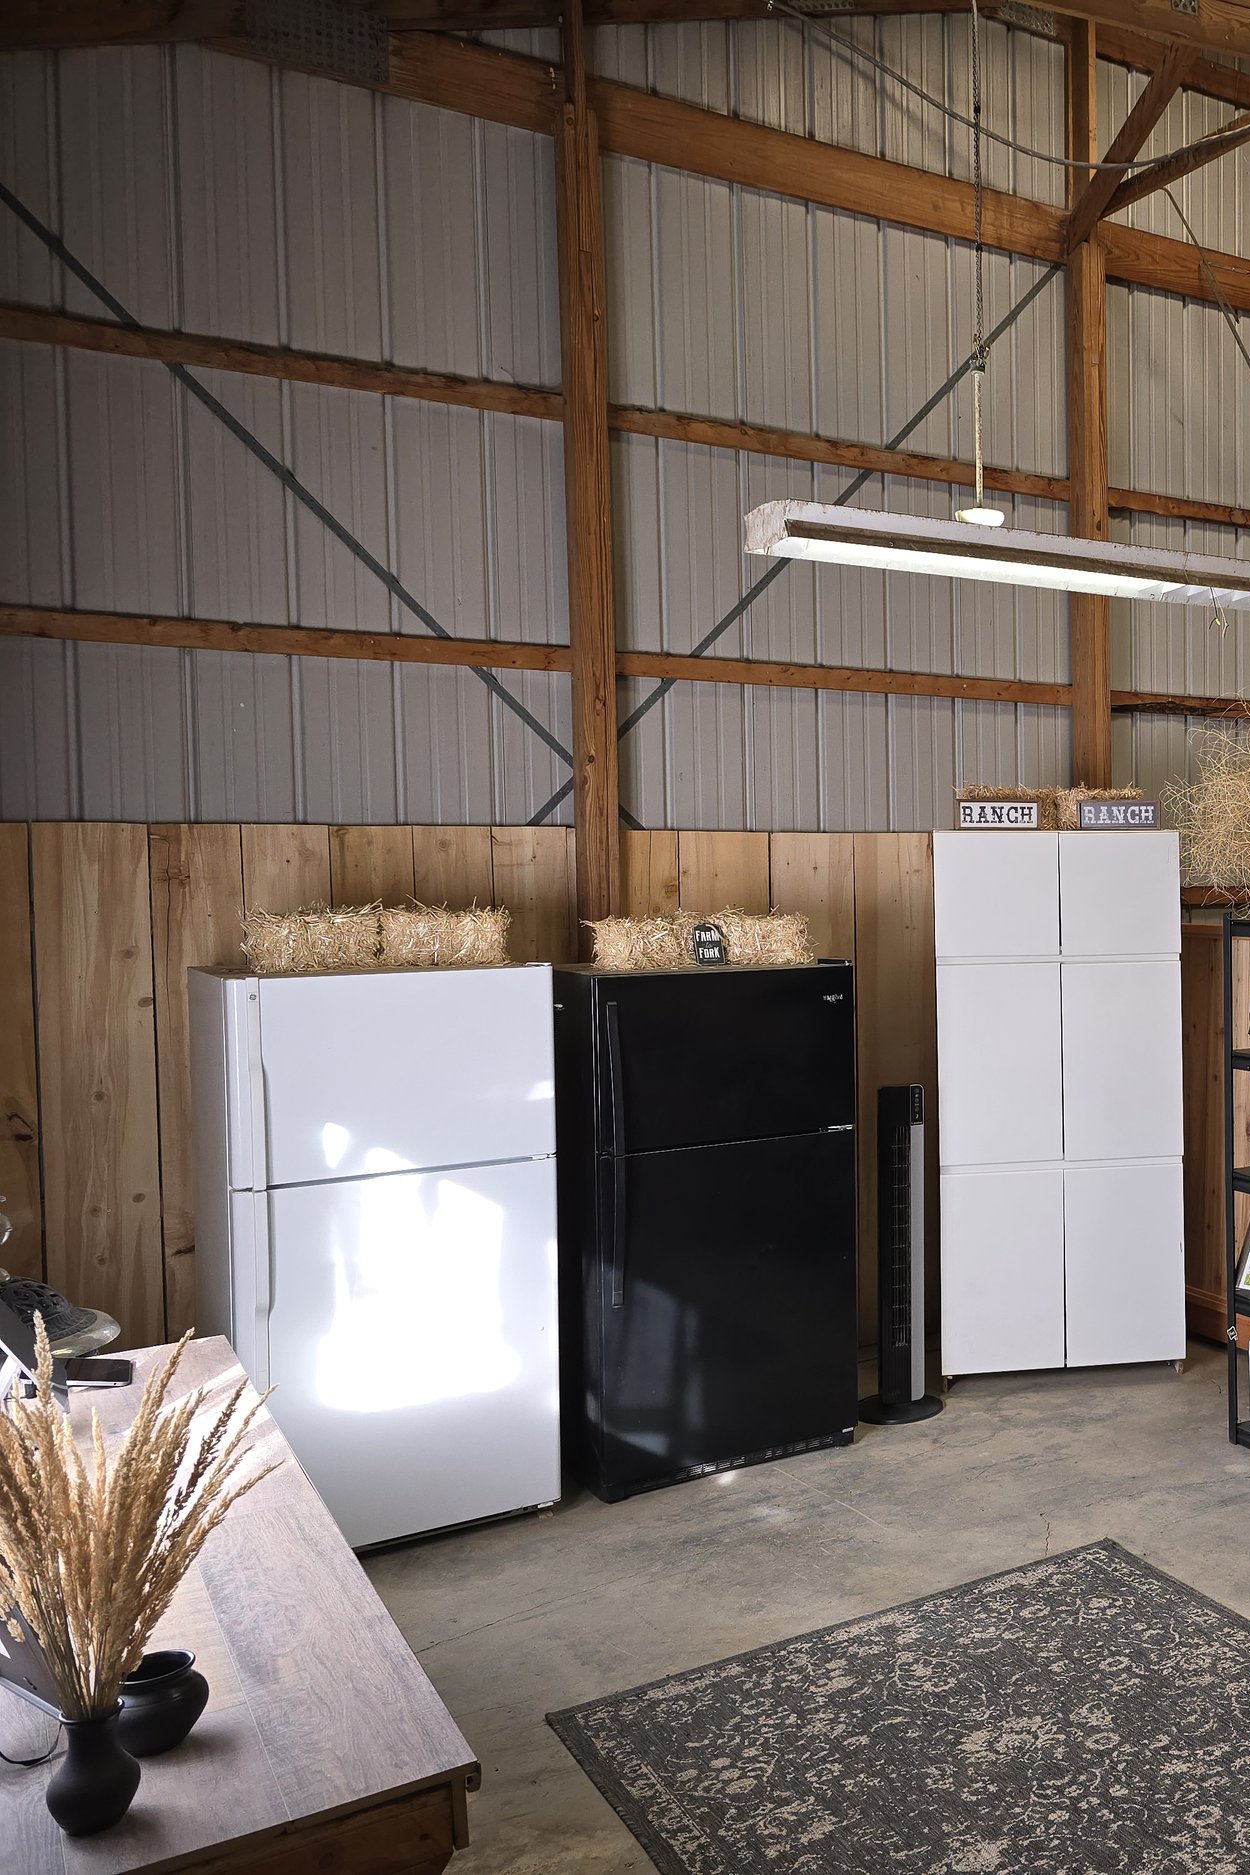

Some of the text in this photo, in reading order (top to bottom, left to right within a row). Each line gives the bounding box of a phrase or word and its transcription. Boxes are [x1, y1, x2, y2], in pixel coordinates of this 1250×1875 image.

[961, 806, 1034, 824] RANCH
[1083, 806, 1154, 824] RANCH
[695, 930, 720, 942] FARM
[699, 947, 720, 958] FORK
